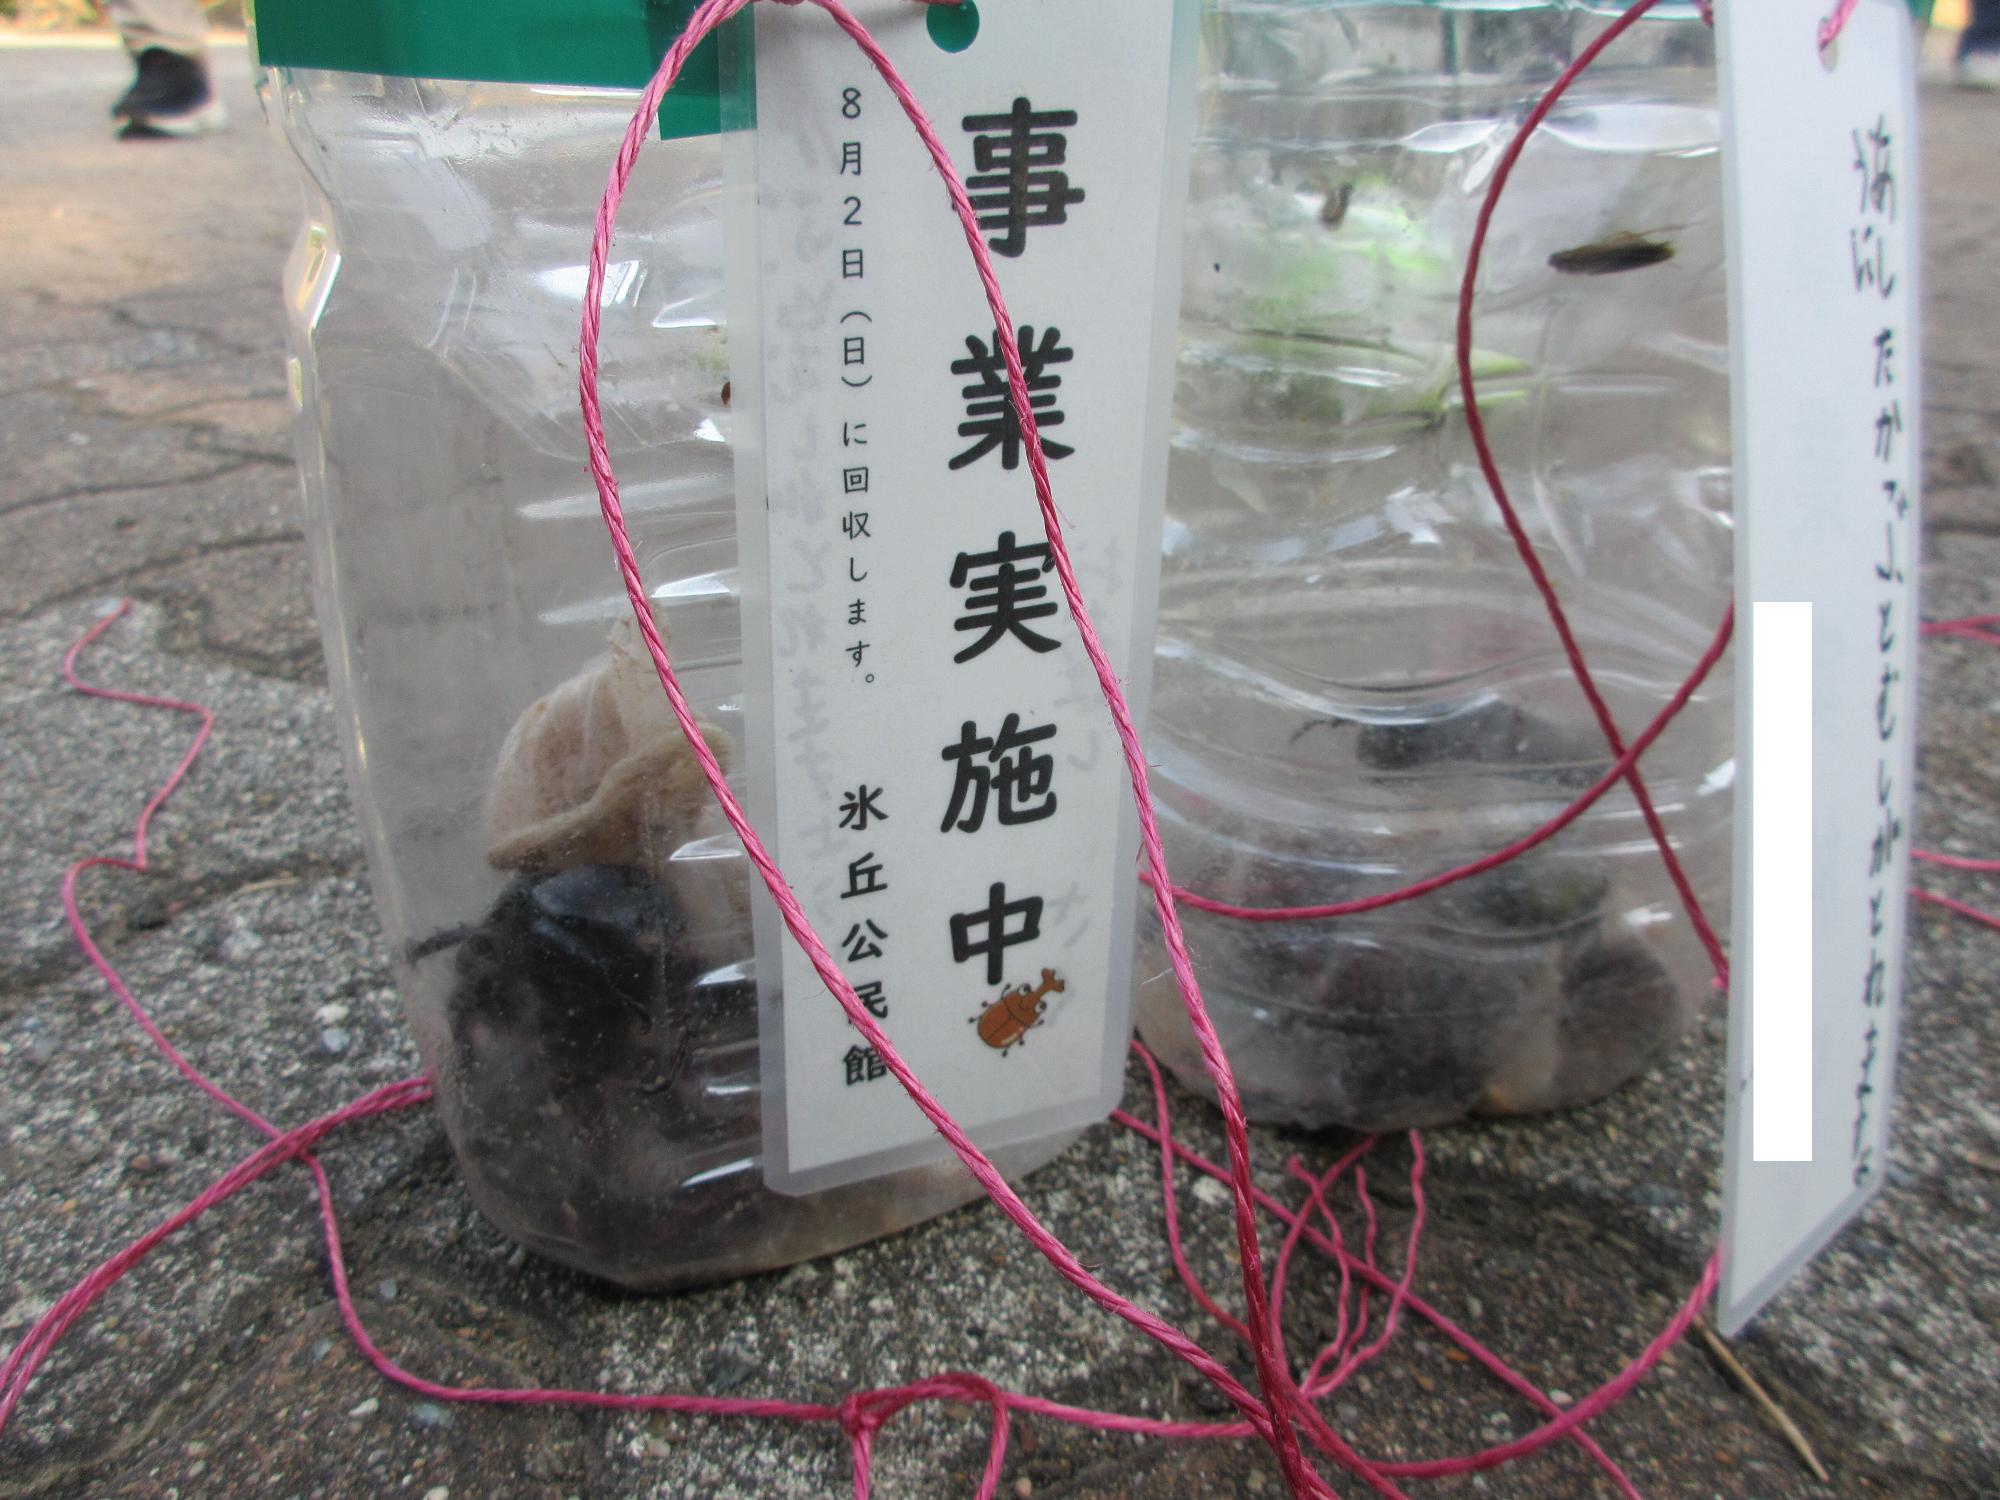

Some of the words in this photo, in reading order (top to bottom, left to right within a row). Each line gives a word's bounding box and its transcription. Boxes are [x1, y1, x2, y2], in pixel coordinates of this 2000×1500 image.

[839, 87, 876, 687] 8月2日（日）に回収します。
[940, 96, 1085, 986] 事業実施中
[838, 785, 889, 1086] 氷丘公民館
